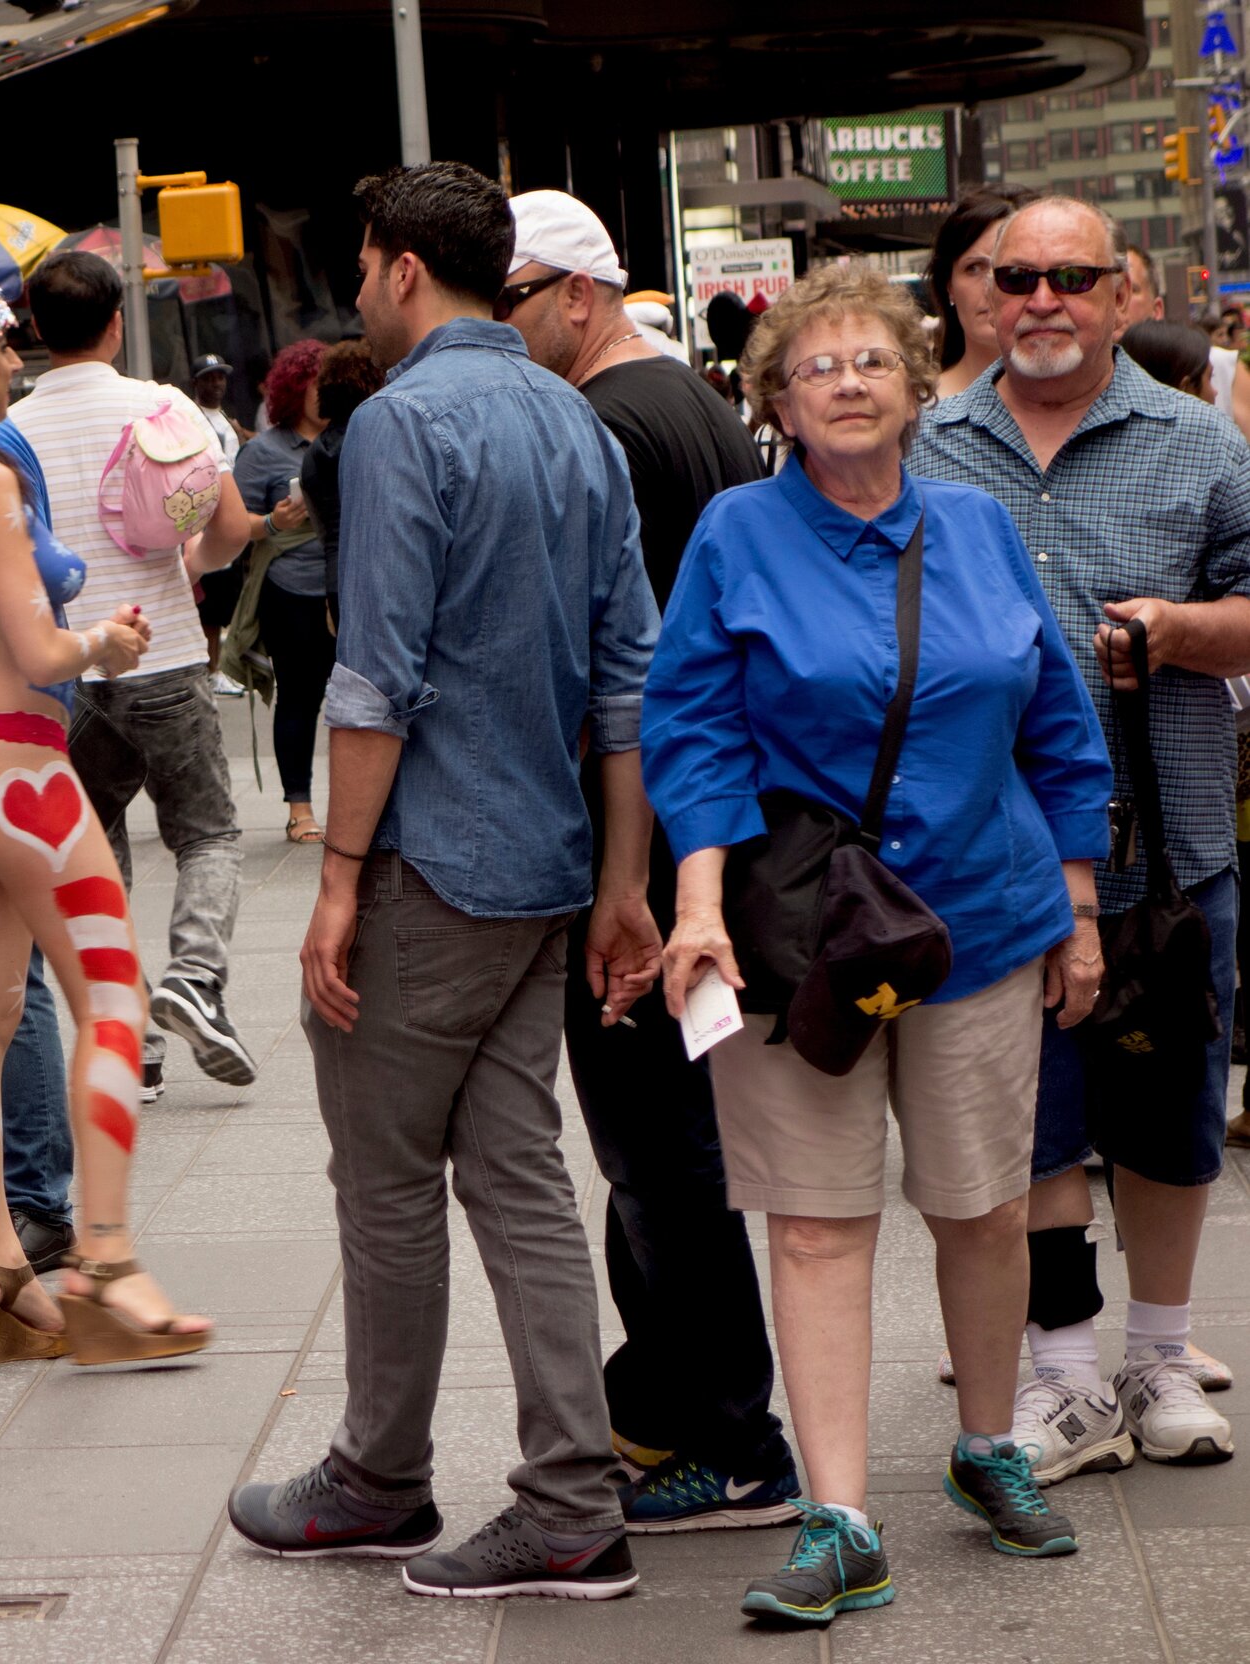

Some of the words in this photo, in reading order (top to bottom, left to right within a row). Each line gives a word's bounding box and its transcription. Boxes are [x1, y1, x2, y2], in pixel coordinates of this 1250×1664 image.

[828, 124, 942, 151] ARBUCKS
[830, 158, 911, 182] OFFEE
[696, 278, 747, 301] IRISH
[752, 275, 789, 296] PUB
[854, 982, 922, 1020] M
[1057, 1412, 1087, 1445] N
